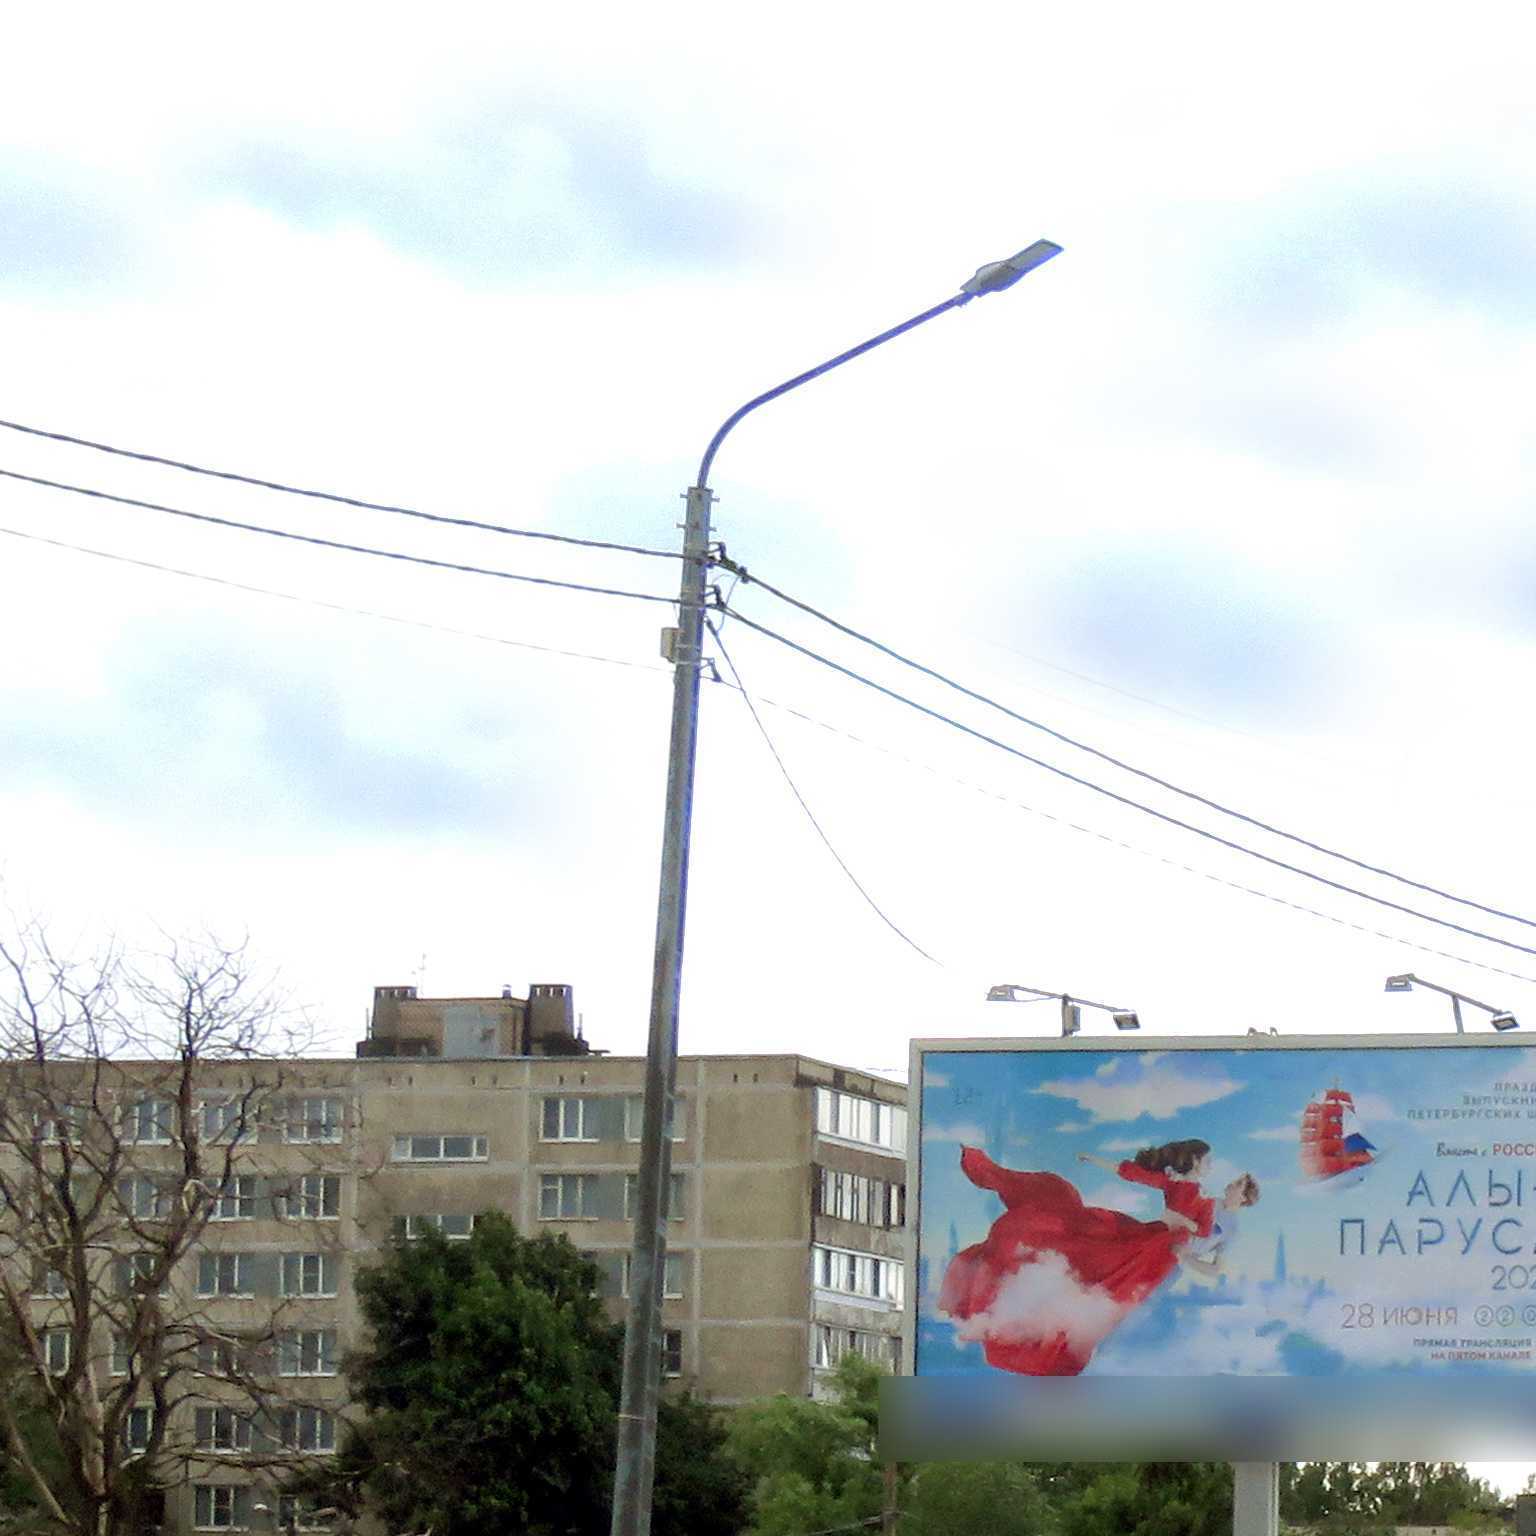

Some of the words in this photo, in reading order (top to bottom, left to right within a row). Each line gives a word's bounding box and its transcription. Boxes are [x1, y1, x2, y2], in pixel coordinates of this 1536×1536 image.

[1407, 1109, 1520, 1120] ПЕТЕРБУРГСКИХ
[1340, 1303, 1375, 1329] 28
[1383, 1306, 1458, 1327] ИЮНЯ
